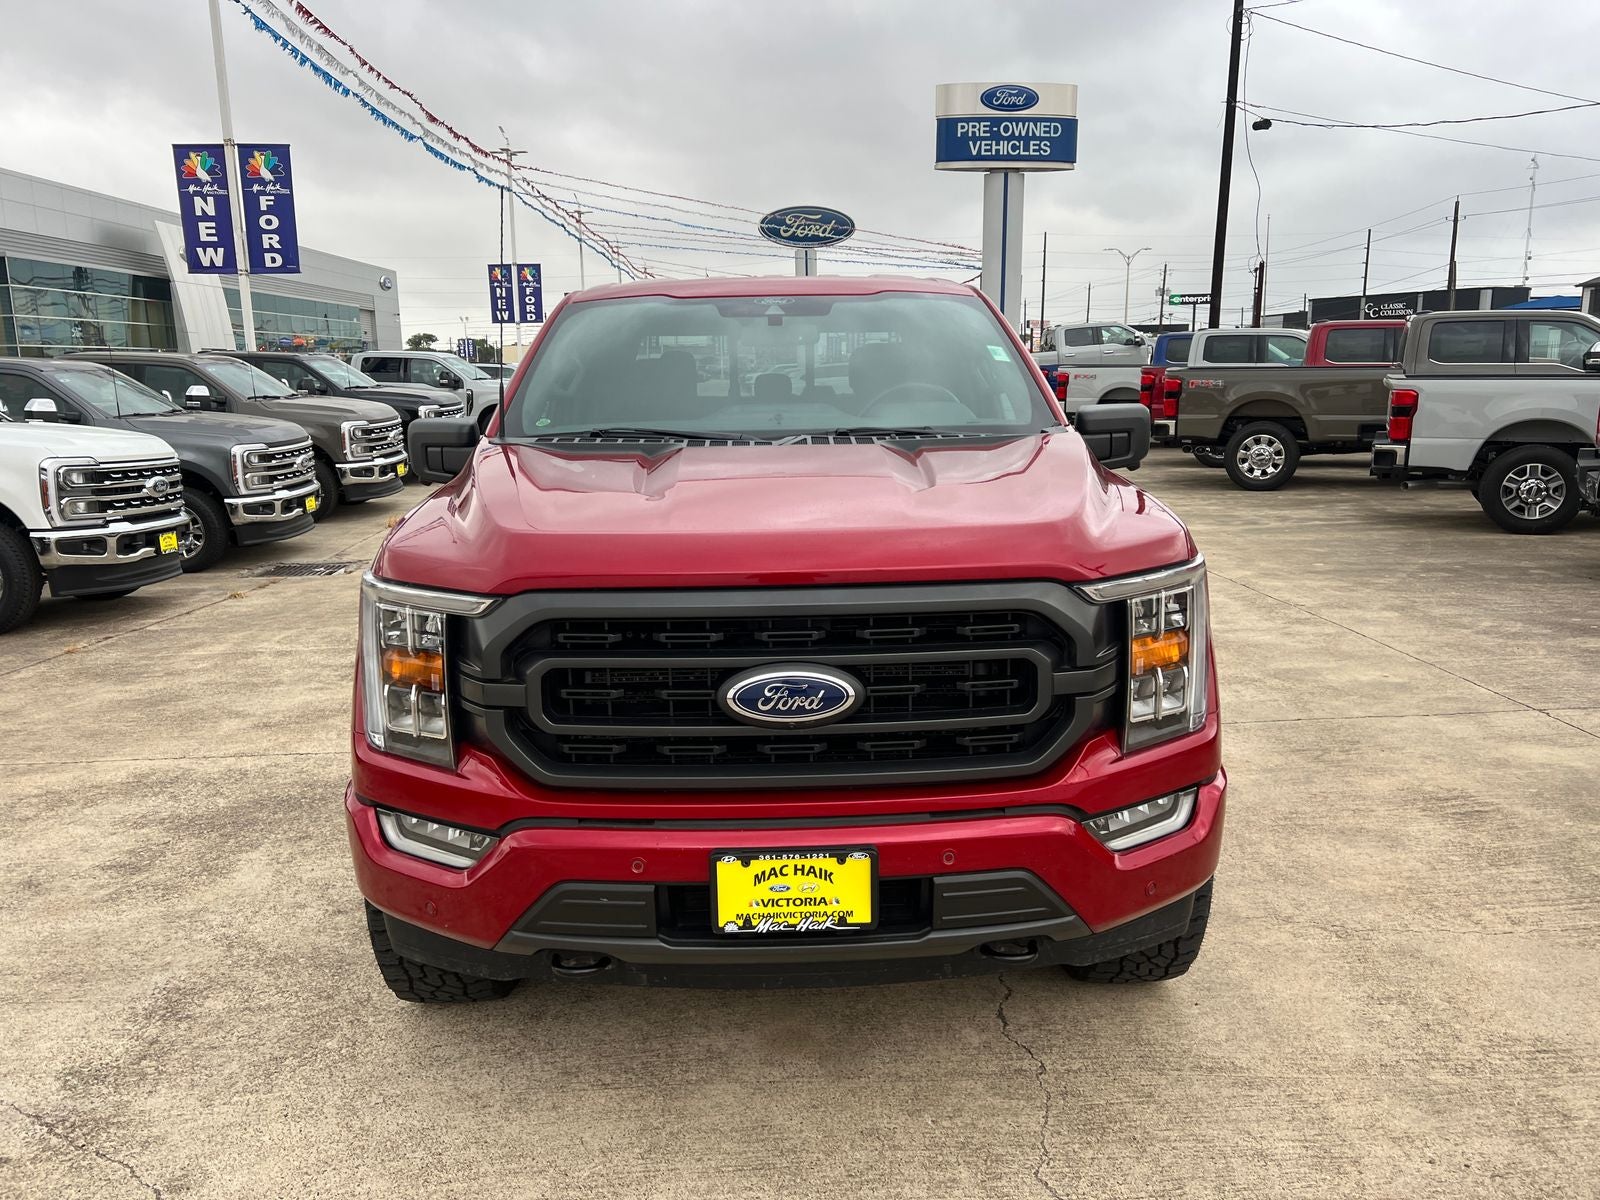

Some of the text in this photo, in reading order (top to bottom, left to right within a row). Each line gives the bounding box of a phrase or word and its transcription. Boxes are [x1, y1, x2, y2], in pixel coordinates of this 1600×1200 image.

[993, 90, 1026, 105] Ford
[969, 141, 1051, 156] VEHICLES
[193, 196, 224, 267] NEW
[259, 195, 283, 268] FORD
[780, 213, 835, 237] Ford
[496, 287, 509, 321] NEW
[525, 287, 536, 321] FORD
[1170, 295, 1211, 304] enterpri
[1380, 302, 1407, 310] CLASSIC
[1380, 308, 1414, 317] COLLISION
[757, 683, 826, 711] Ford
[753, 863, 834, 887] MAC HAIK
[760, 897, 828, 908] VICTORIA
[754, 915, 837, 933] Mac Haik
